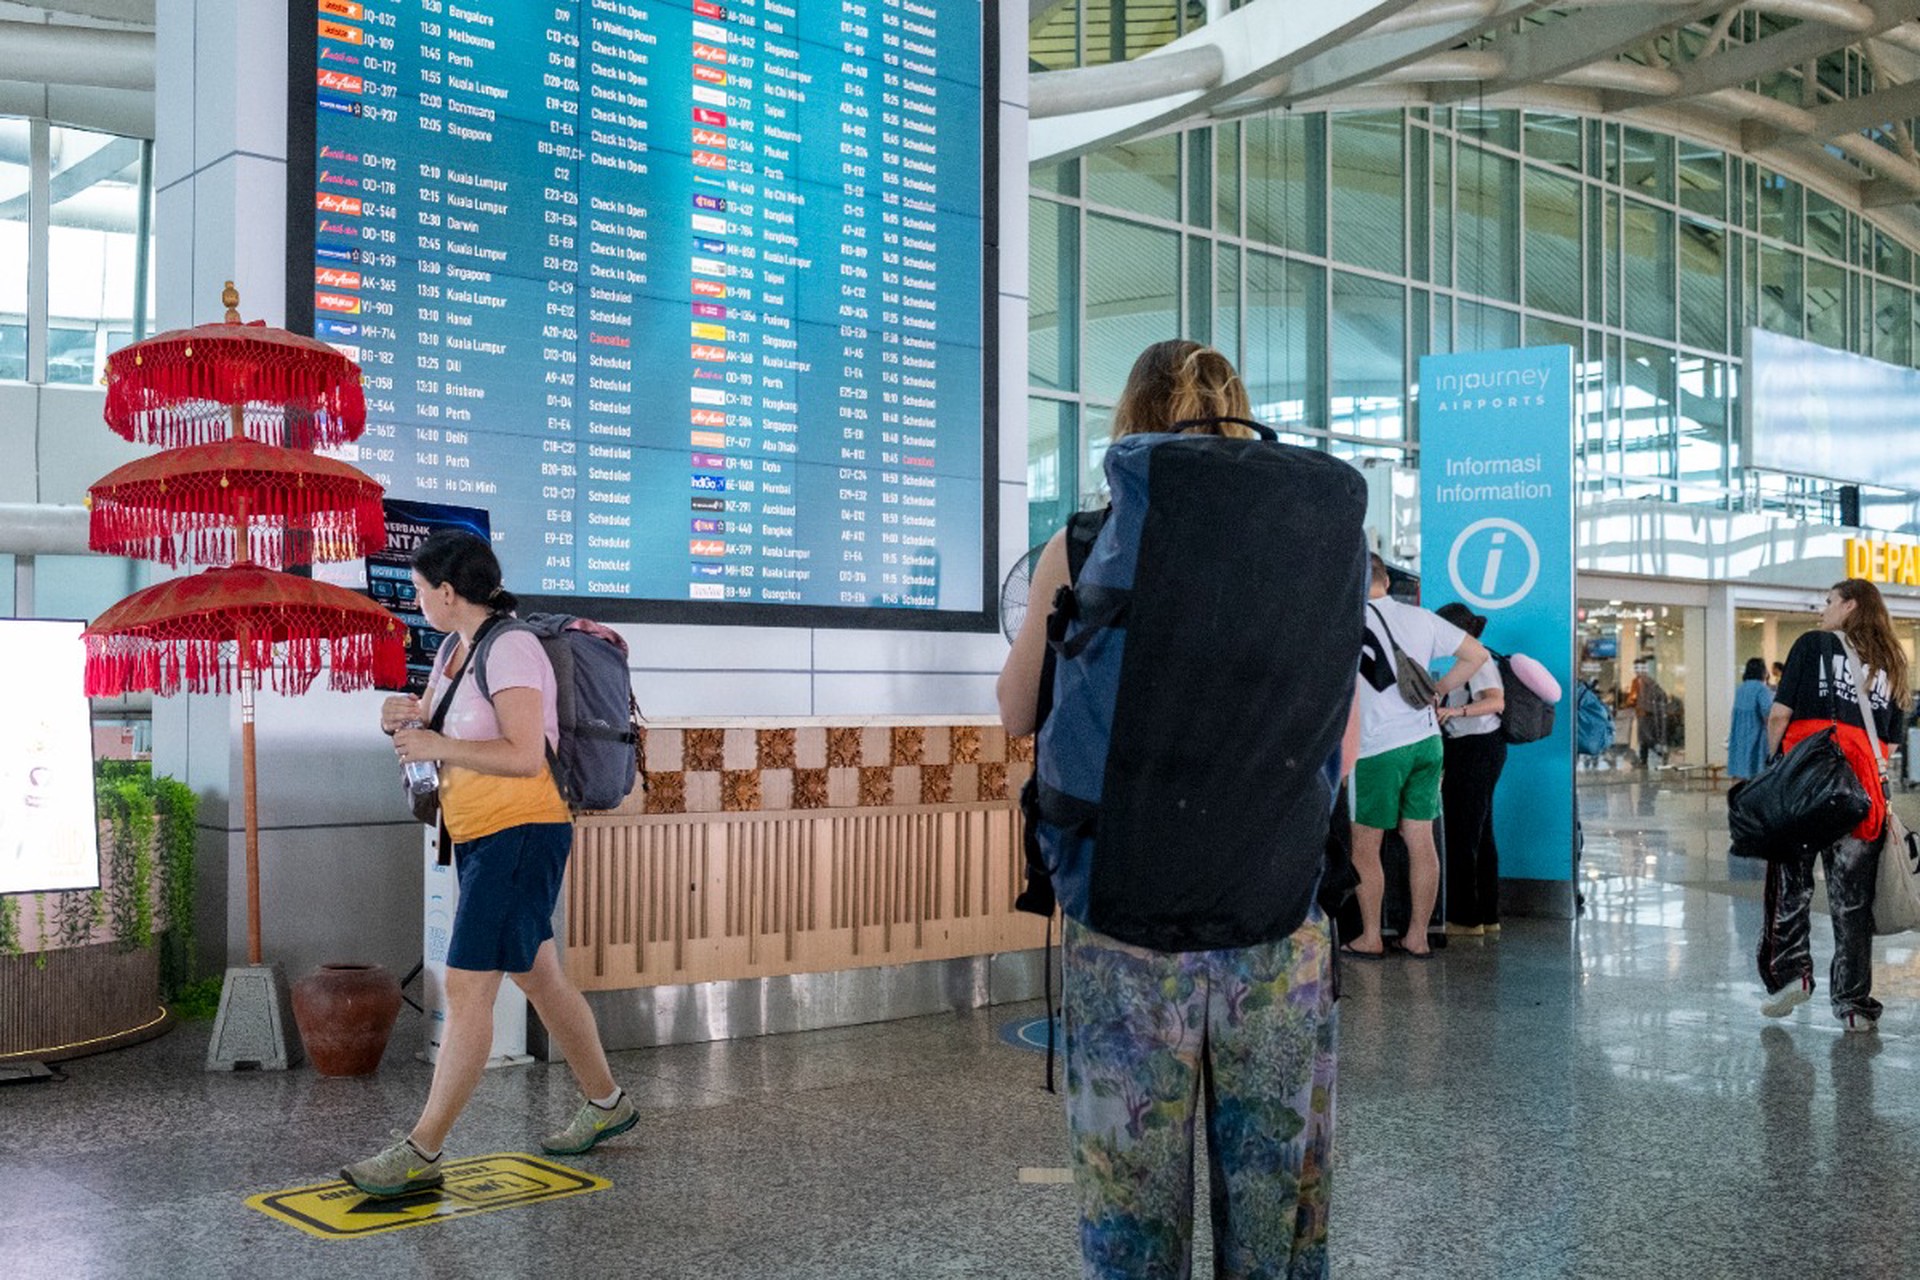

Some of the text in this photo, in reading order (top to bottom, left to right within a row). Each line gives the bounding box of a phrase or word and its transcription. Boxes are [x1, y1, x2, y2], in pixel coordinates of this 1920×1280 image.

[626, 5, 648, 20] Open
[448, 4, 648, 64] Bangalore Check In Open
[591, 17, 657, 45] To Waiting Room
[902, 19, 936, 37] Scheduled
[420, 21, 647, 86] 11:30 Melbourne Check In Open
[902, 58, 936, 76] Scheduled
[447, 51, 473, 68] Perth
[591, 84, 617, 101] Check
[616, 90, 626, 103] In
[626, 93, 647, 108] Open
[902, 78, 936, 96] Scheduled
[448, 75, 474, 92] Kuala
[475, 81, 508, 98] Lumpur
[591, 107, 617, 123] Check
[616, 112, 627, 125] In
[626, 115, 647, 129] Open
[902, 98, 936, 115] Scheduled
[419, 92, 647, 152] 12:00 Donmuang Check In Open
[419, 116, 442, 132] 12:05
[447, 122, 492, 142] Singapore
[591, 152, 617, 167] Check
[616, 157, 626, 170] In
[626, 159, 647, 174] Open
[554, 166, 570, 181] C12
[902, 156, 936, 174] Scheduled
[419, 164, 647, 217] 12:10 Kuala Lumpur Check In Open
[418, 188, 647, 239] 12:15 Kuala Lumpur Check In Open
[418, 211, 647, 261] 12:30 Darwin Check In Open
[902, 236, 936, 252] Scheduled
[446, 240, 473, 255] Kuala
[473, 245, 507, 261] Lumpur
[590, 264, 616, 278] Check
[616, 268, 625, 280] In
[625, 269, 647, 283] Open
[902, 256, 936, 271] Scheduled
[446, 264, 491, 282] Singapore
[590, 287, 632, 303] Scheduled
[902, 275, 936, 290] Scheduled
[446, 288, 472, 303] Kuala
[473, 292, 506, 308] Lumpur
[589, 309, 631, 326] Scheduled
[446, 312, 472, 326] Hanoi
[589, 331, 630, 347] Cancelled
[902, 315, 936, 330] Scheduled
[446, 336, 472, 350] Kuala
[472, 339, 506, 354] Lumpur
[589, 354, 631, 370] Scheduled
[902, 355, 936, 369] Scheduled
[417, 355, 631, 392] 13:25 Dili Scheduled
[902, 375, 936, 389] Scheduled
[1436, 367, 1551, 396] injourney
[445, 383, 484, 398] Brisbane
[589, 399, 631, 415] Scheduled
[902, 395, 936, 408] Scheduled
[1438, 395, 1545, 411] AIRPORTS
[445, 406, 471, 420] Perth
[589, 421, 631, 437] Scheduled
[902, 414, 936, 428] Scheduled
[445, 430, 631, 459] Delhi Scheduled
[902, 434, 936, 448] Scheduled
[445, 454, 631, 481] Perth Scheduled
[1446, 454, 1541, 477] Informasi
[902, 474, 935, 487] Scheduled
[588, 490, 631, 504] Scheduled
[1436, 480, 1552, 503] Information
[588, 512, 630, 526] Scheduled
[902, 514, 935, 527] Scheduled
[588, 535, 630, 548] Scheduled
[588, 558, 630, 571] Scheduled
[902, 554, 935, 566] Scheduled
[588, 580, 630, 593] Scheduled
